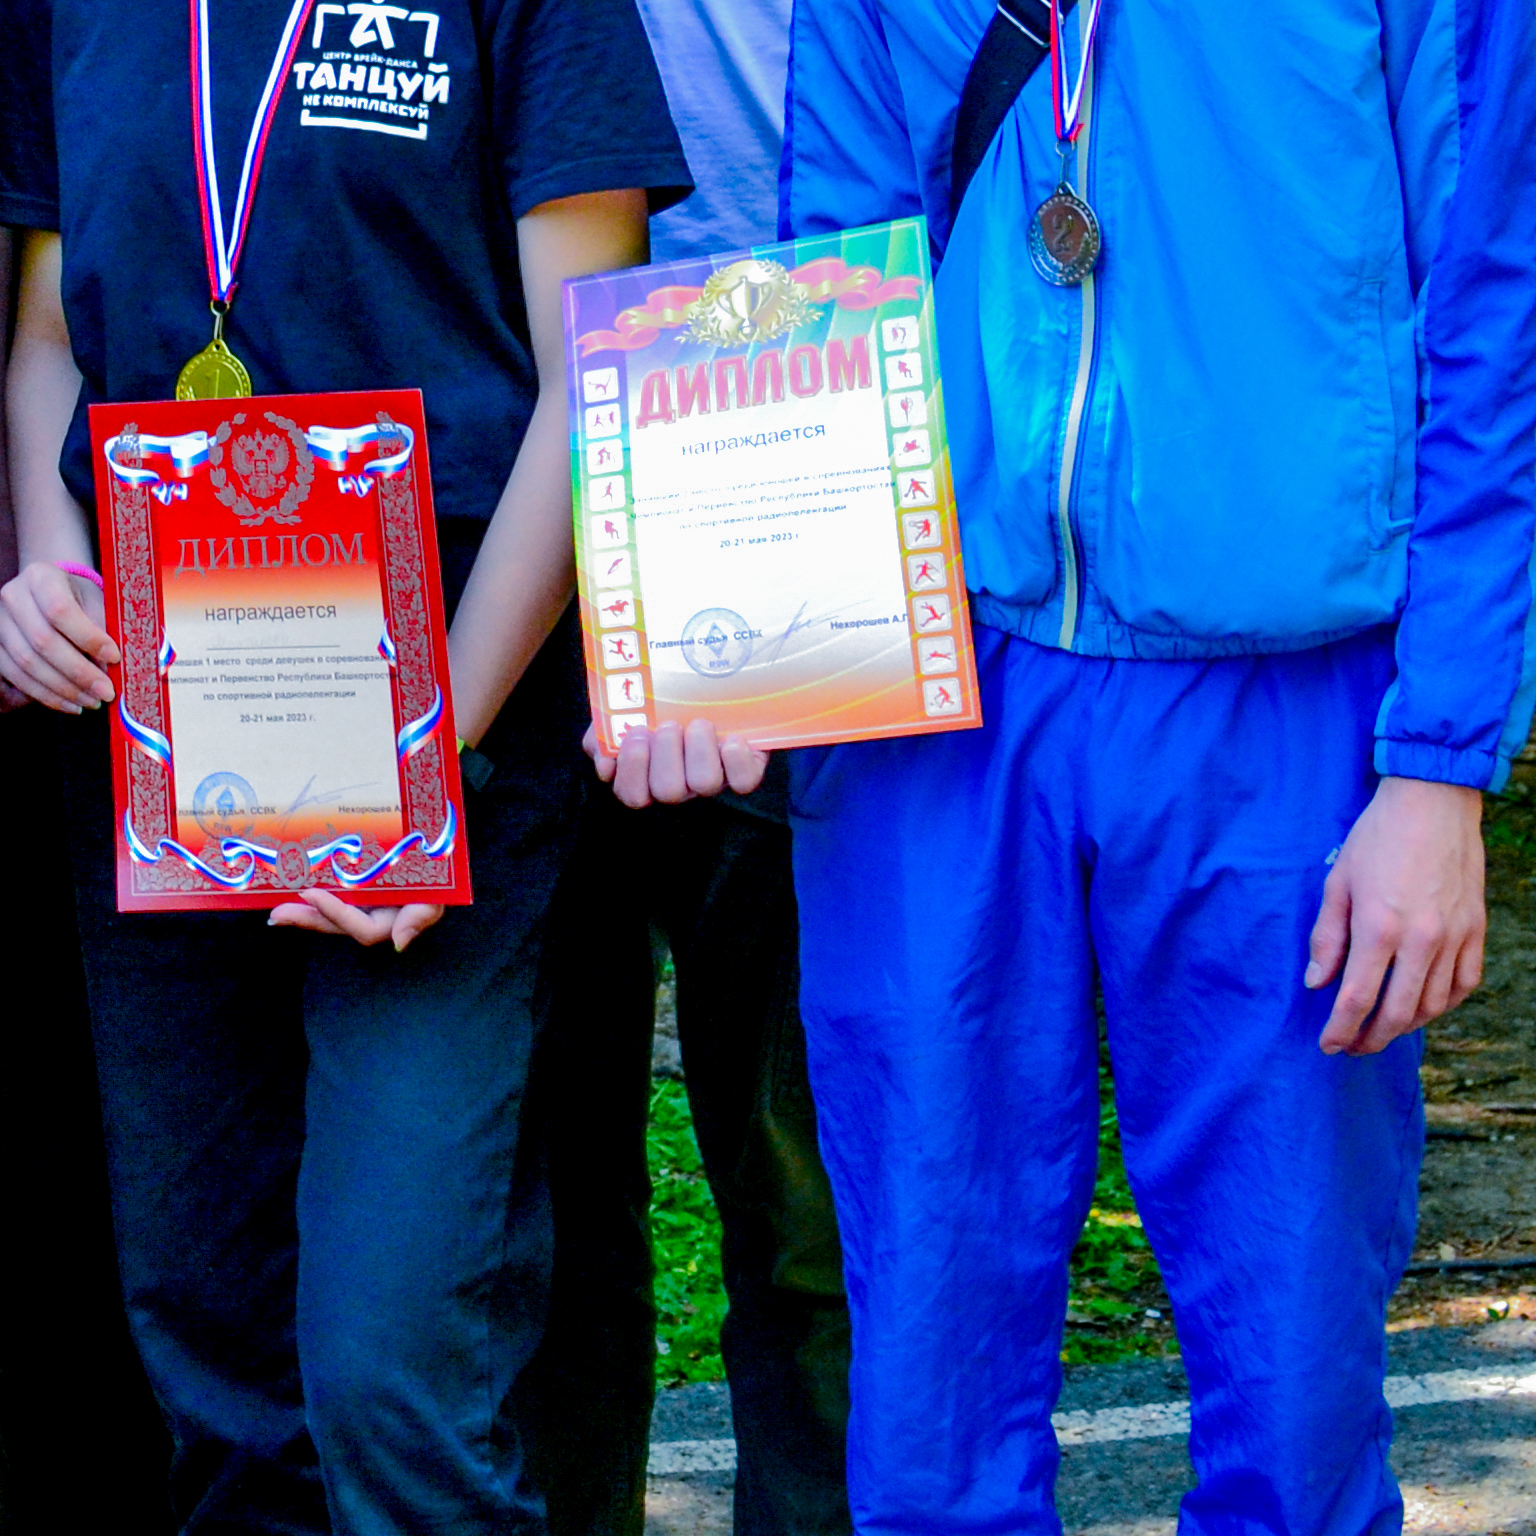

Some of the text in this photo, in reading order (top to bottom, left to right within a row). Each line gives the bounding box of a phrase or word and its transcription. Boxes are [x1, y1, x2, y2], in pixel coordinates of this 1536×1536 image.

[322, 51, 352, 61] ЦЕНТР
[292, 61, 451, 105] ТАНЦУЙ
[302, 94, 430, 120] НЕ КОМПЛЕКСУЙ
[636, 333, 874, 430] ДИПЛОМ
[681, 423, 826, 457] награждается
[770, 532, 794, 543] 2023
[174, 531, 367, 581] ДИПЛОМ
[204, 604, 338, 625] награждается
[830, 617, 890, 631] Нехорошев
[213, 657, 241, 666] место
[245, 656, 273, 667] среди
[220, 673, 275, 684] Первенство
[277, 672, 332, 683] Республики
[203, 693, 215, 701] по
[217, 691, 273, 703] спортивной
[239, 713, 264, 724] 20-21
[266, 714, 284, 723] мая
[286, 712, 307, 723] 2023
[338, 804, 392, 815] Нехорошев
